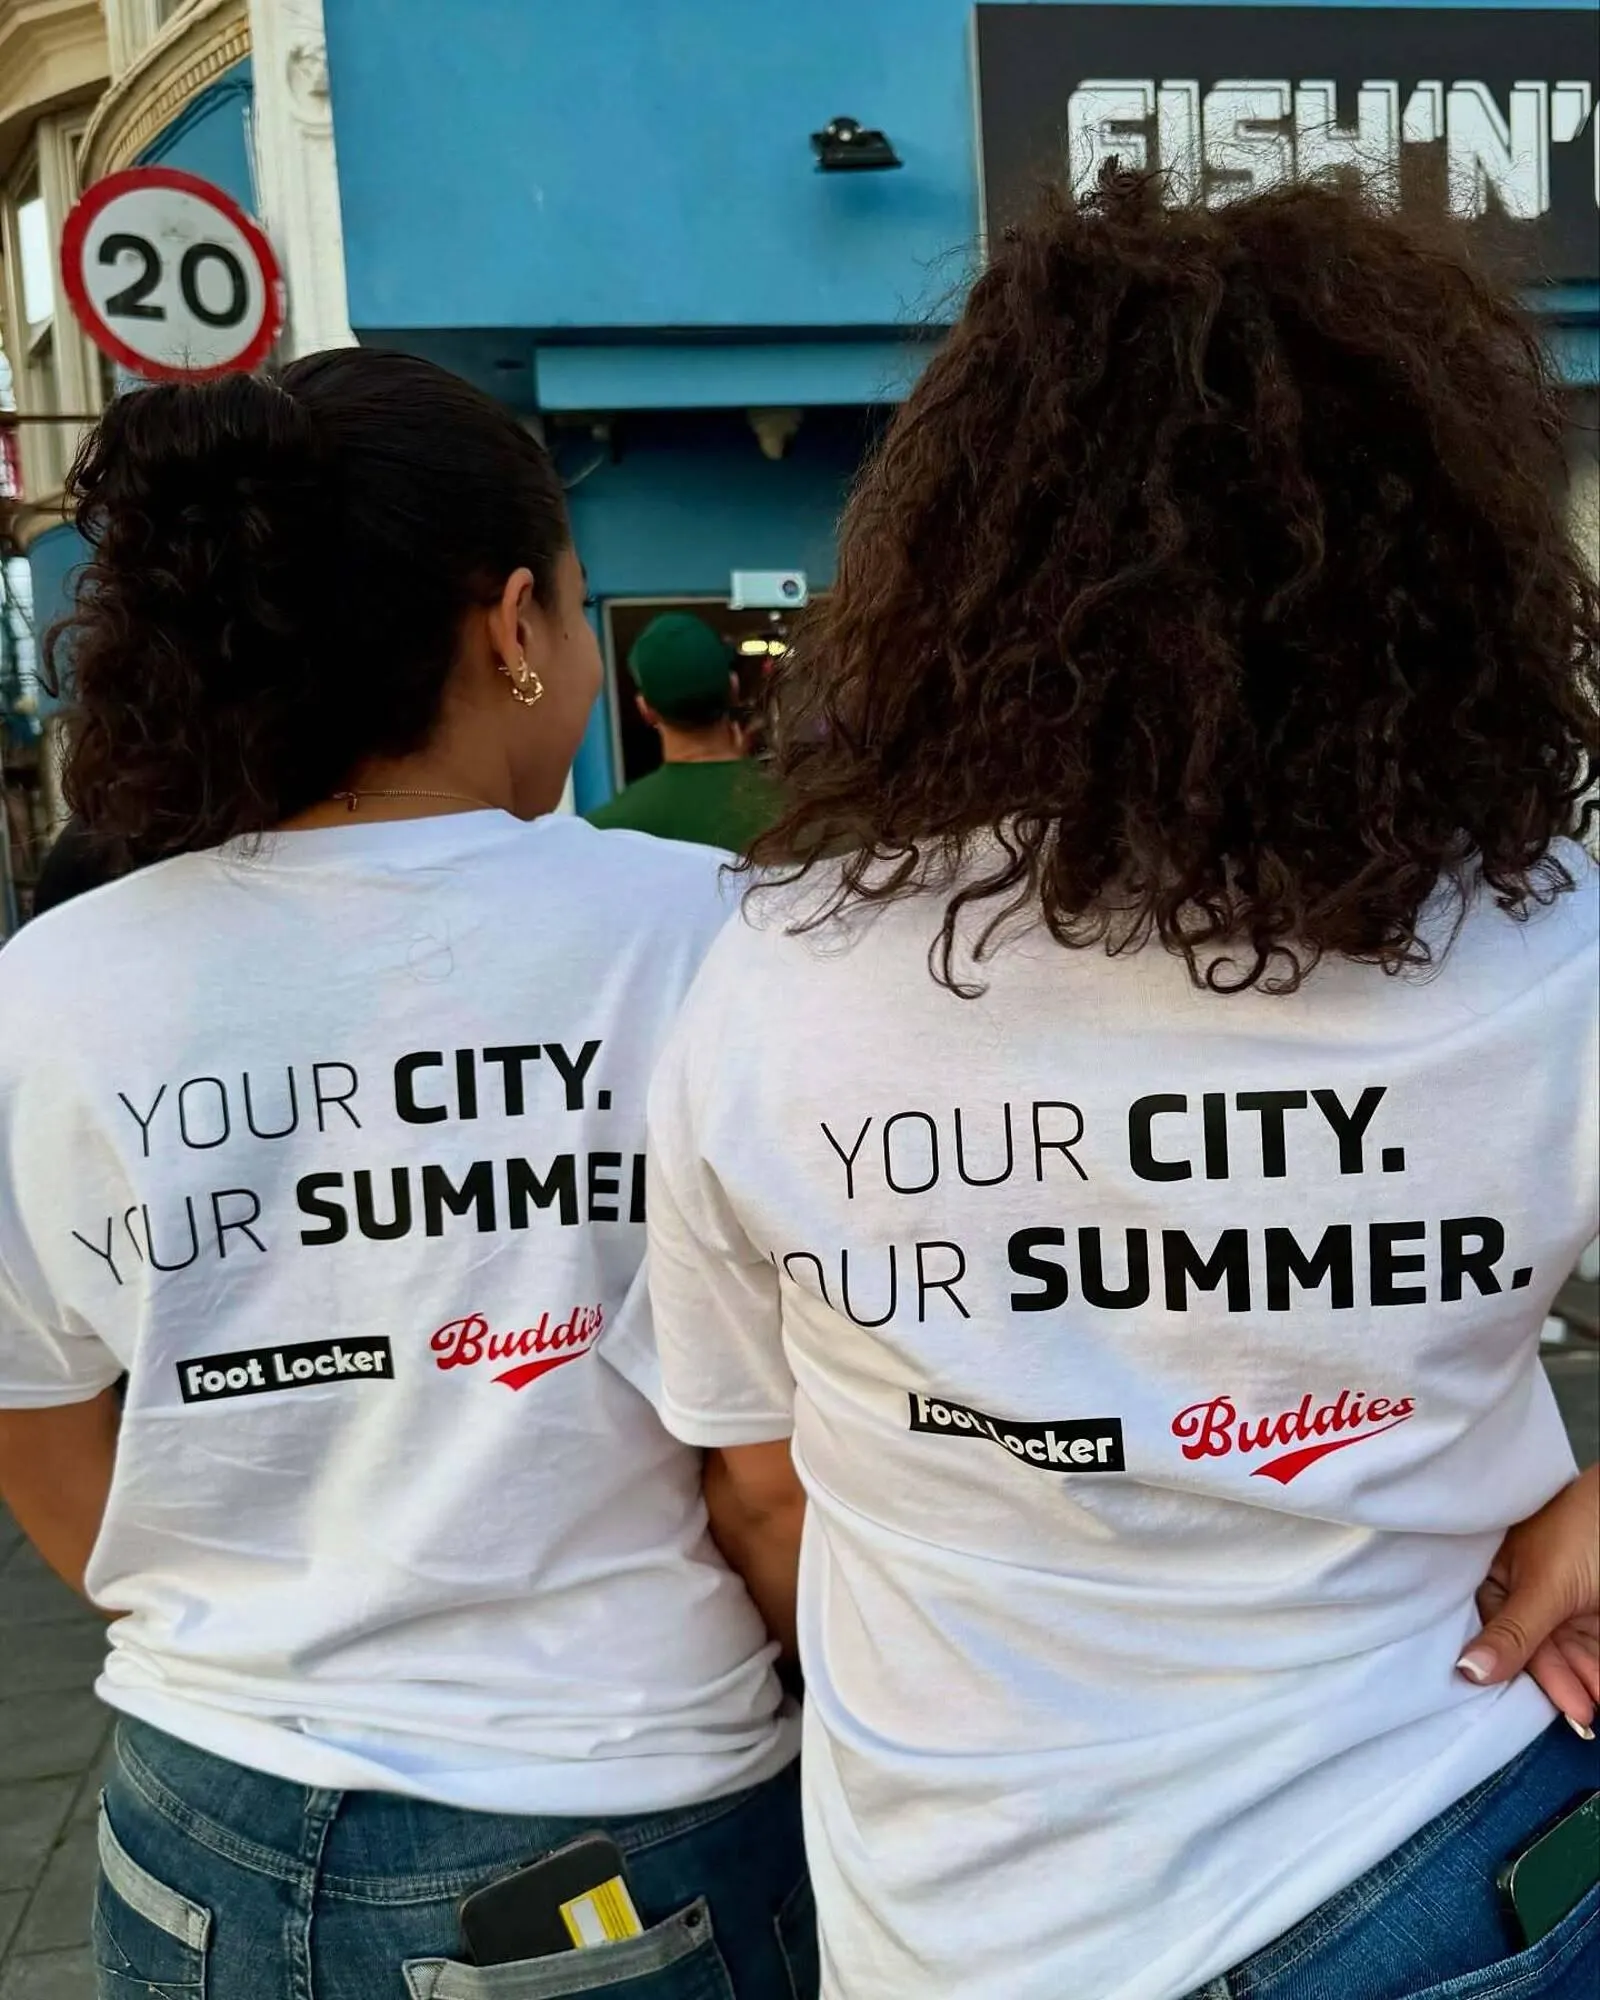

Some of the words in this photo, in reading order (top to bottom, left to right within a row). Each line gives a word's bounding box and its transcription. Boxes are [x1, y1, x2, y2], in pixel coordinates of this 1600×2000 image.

[98, 233, 249, 330] 20
[118, 1062, 361, 1157] YOUR
[393, 1039, 612, 1125] CITY.
[820, 1101, 1089, 1200] YOUR
[1128, 1086, 1405, 1182] CITY.
[769, 1241, 971, 1328] OUR
[1007, 1216, 1534, 1313] SUMMER.
[186, 1358, 266, 1396] Foot
[272, 1345, 386, 1382] Locker
[1171, 1390, 1416, 1461] Buddies
